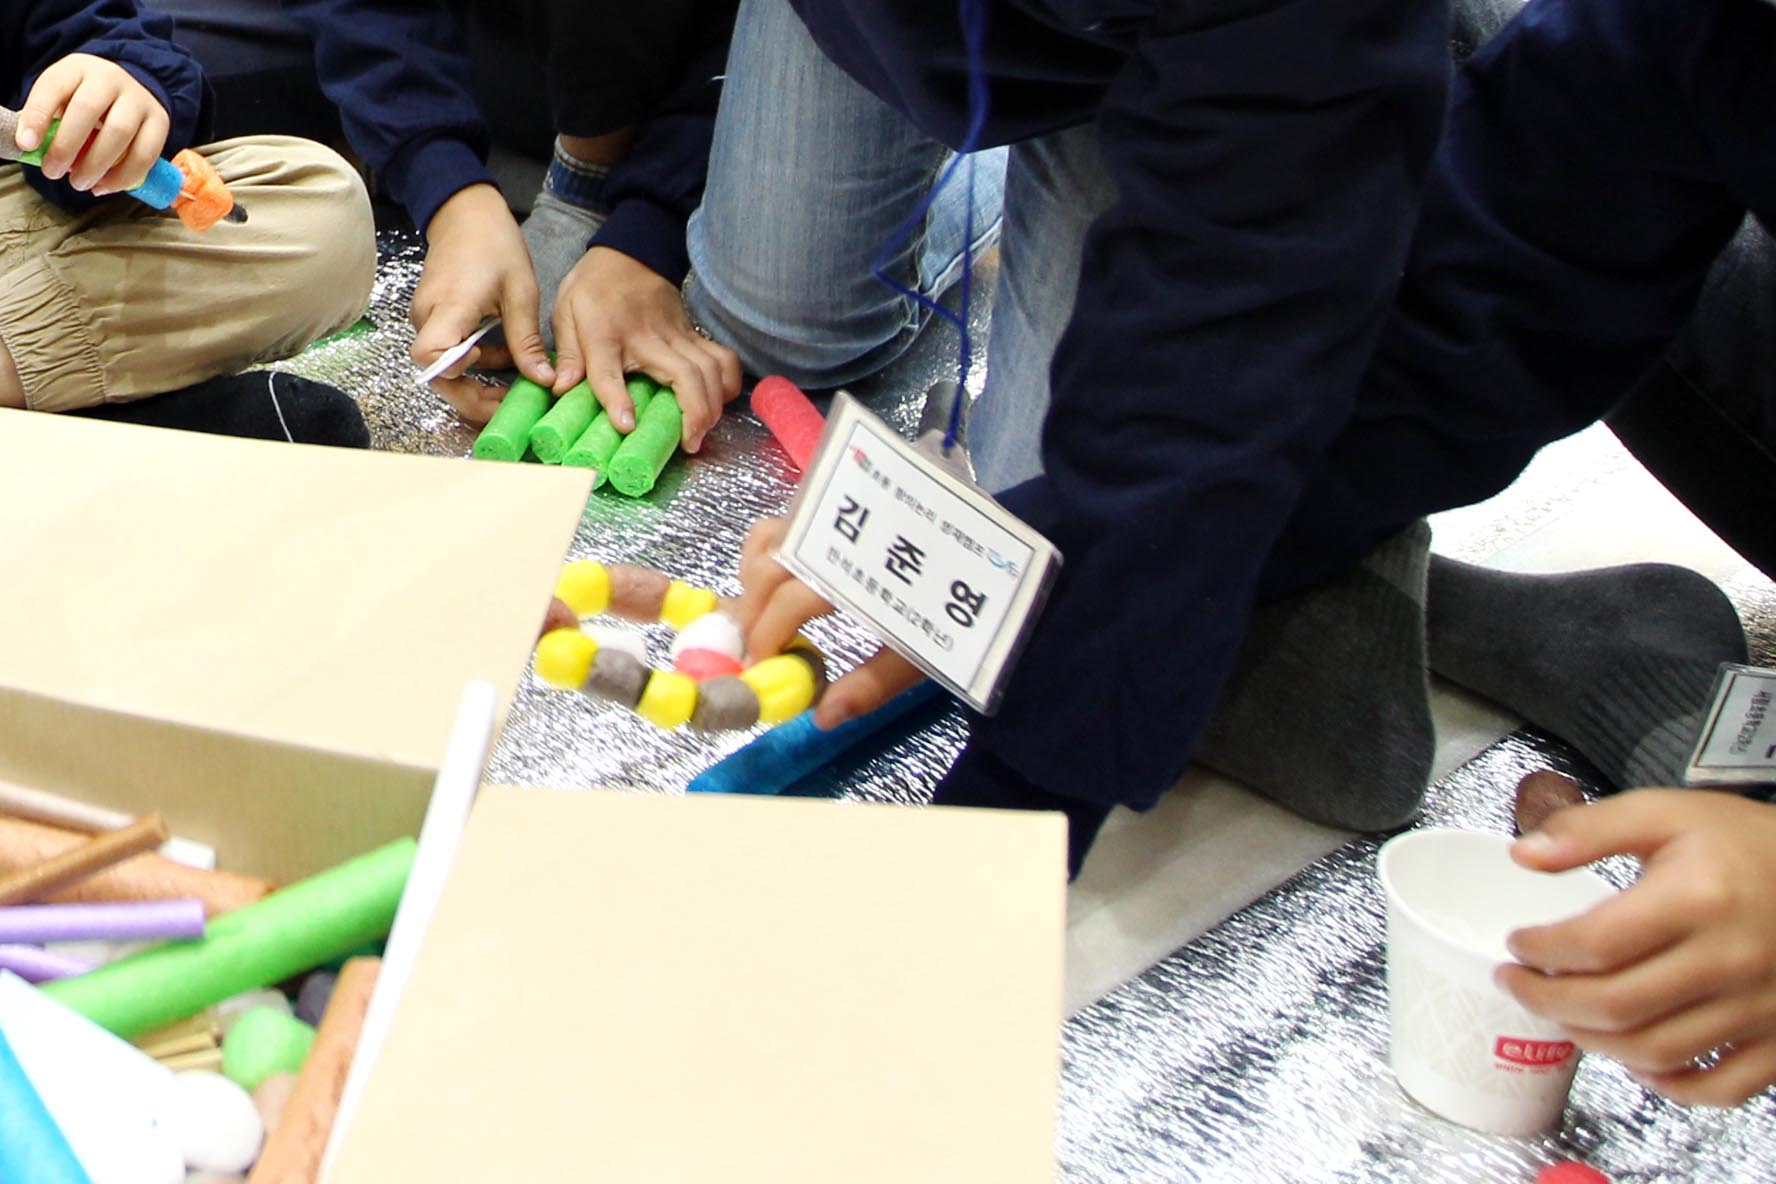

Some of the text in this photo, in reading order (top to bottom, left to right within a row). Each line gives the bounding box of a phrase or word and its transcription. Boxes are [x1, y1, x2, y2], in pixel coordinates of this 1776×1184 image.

[833, 494, 989, 628] 김 준 영
